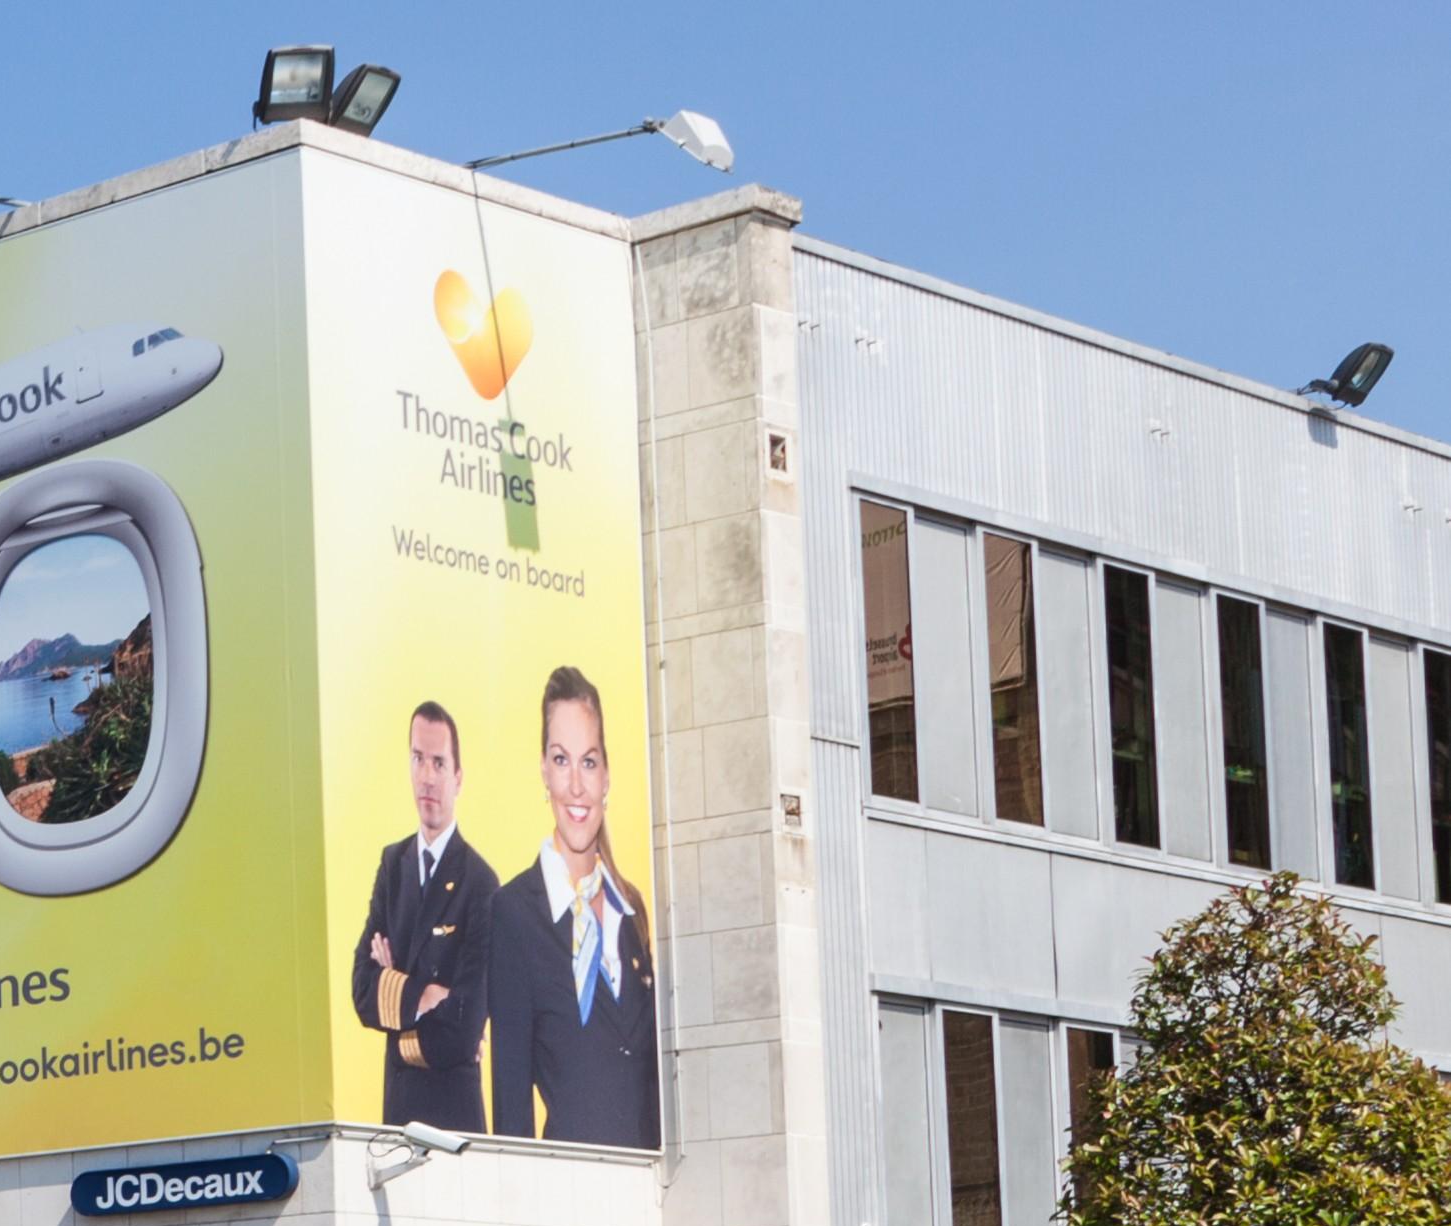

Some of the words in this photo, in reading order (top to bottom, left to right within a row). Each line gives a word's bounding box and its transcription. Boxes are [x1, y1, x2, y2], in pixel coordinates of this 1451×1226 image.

[396, 390, 503, 453] Thomas
[508, 422, 573, 472] Cook
[440, 448, 537, 507] Airlines
[392, 524, 490, 577] Welcome
[495, 558, 521, 583] on
[526, 556, 585, 599] board
[95, 1169, 265, 1210] JCDecaux
